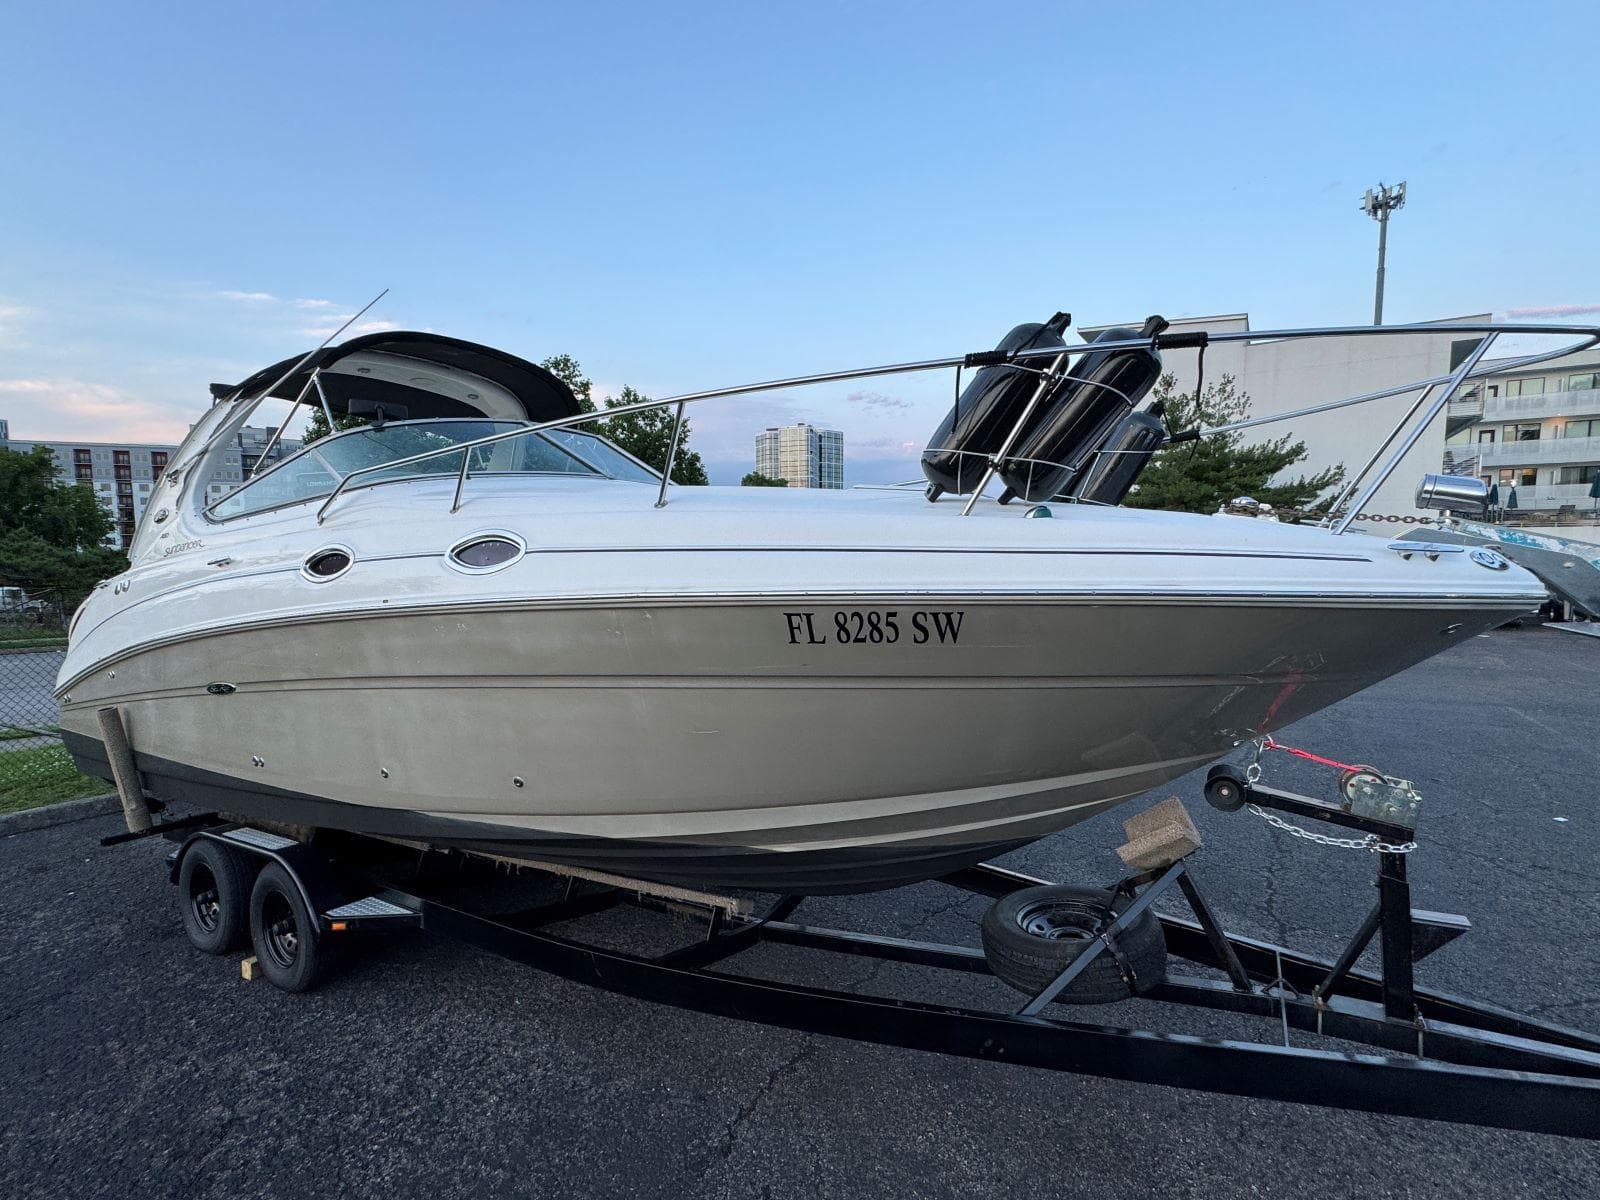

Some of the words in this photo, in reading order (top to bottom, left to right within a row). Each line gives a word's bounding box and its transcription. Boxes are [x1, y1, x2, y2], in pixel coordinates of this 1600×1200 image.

[783, 612, 826, 644] FL
[834, 611, 900, 644] 8285
[911, 611, 965, 644] SW
